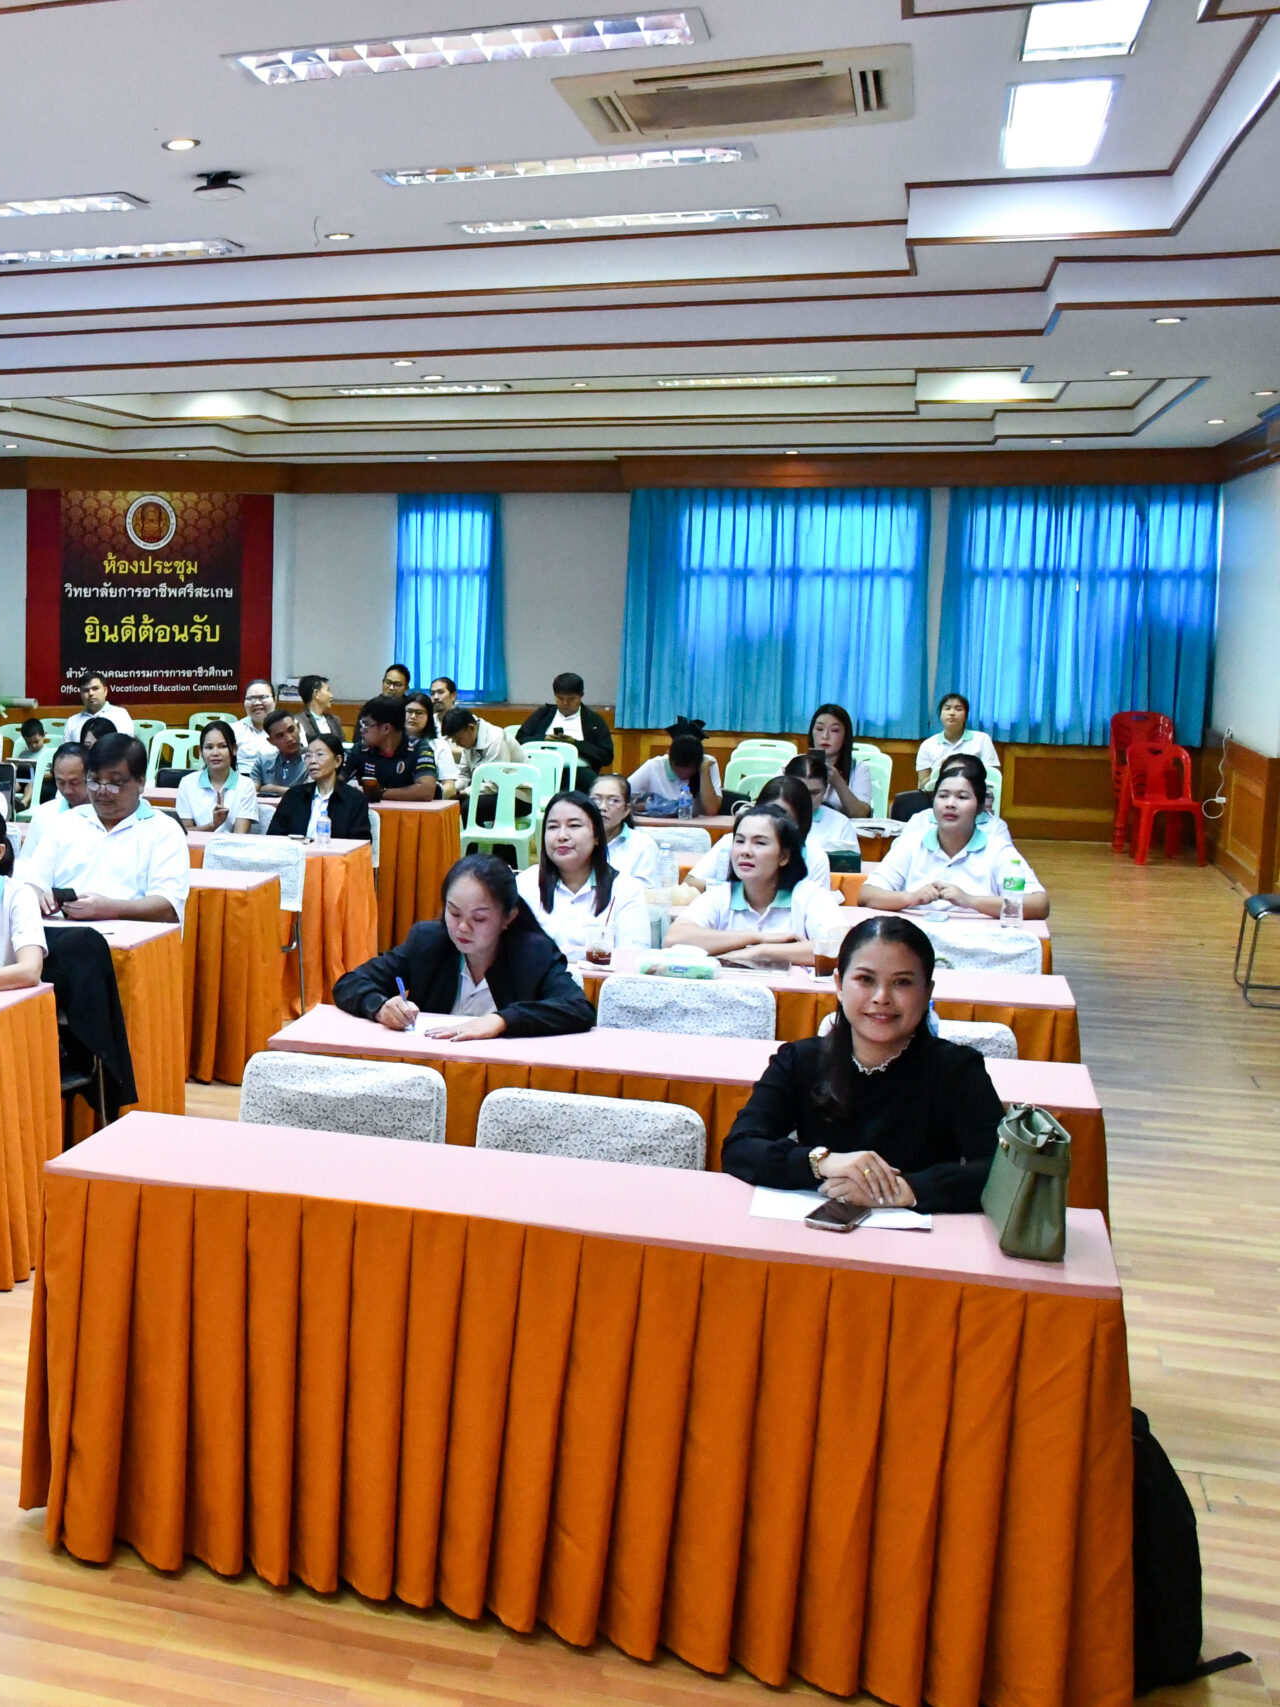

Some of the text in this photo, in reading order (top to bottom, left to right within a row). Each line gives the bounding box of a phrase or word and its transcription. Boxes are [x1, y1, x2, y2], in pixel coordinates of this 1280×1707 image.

[103, 552, 198, 581] ห้องประชุม
[64, 582, 234, 599] วิทยาลัยการอาชีพศรีสะเกษ
[84, 614, 221, 643] ยินดีต้อนรับ
[66, 666, 233, 679] สำนันคณะกรรมการการอาชีวศึกษา
[110, 684, 151, 693] Vocational
[153, 684, 190, 692] Education
[192, 683, 238, 691] Commission
